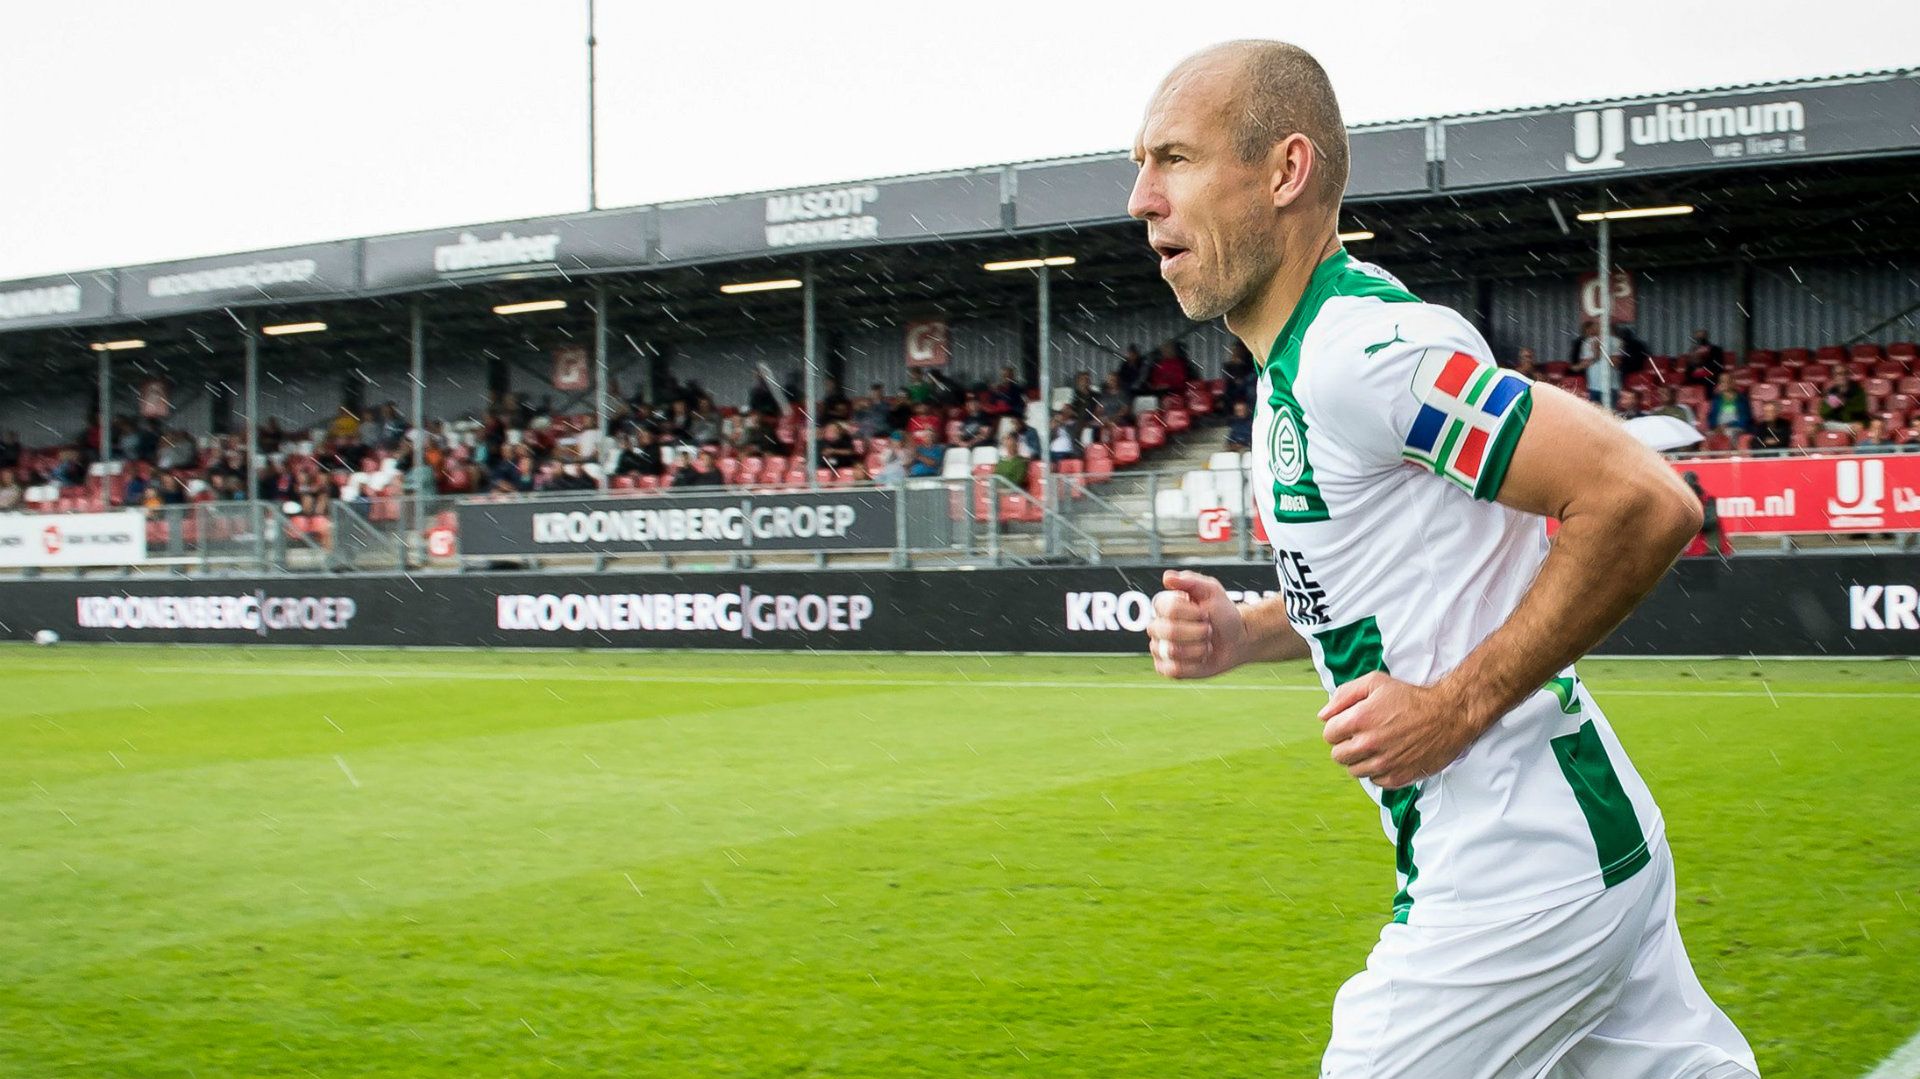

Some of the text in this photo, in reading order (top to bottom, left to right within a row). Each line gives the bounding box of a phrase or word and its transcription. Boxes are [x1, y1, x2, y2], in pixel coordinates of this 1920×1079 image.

[1631, 101, 1805, 145] ultimum
[765, 215, 879, 247] WORKWEAR
[533, 504, 856, 544] KROONENBERG GROEP
[77, 595, 357, 630] KROONENBERG GROEP
[497, 593, 874, 632] KROONENBERG GROEP
[1850, 585, 1920, 631] KR
